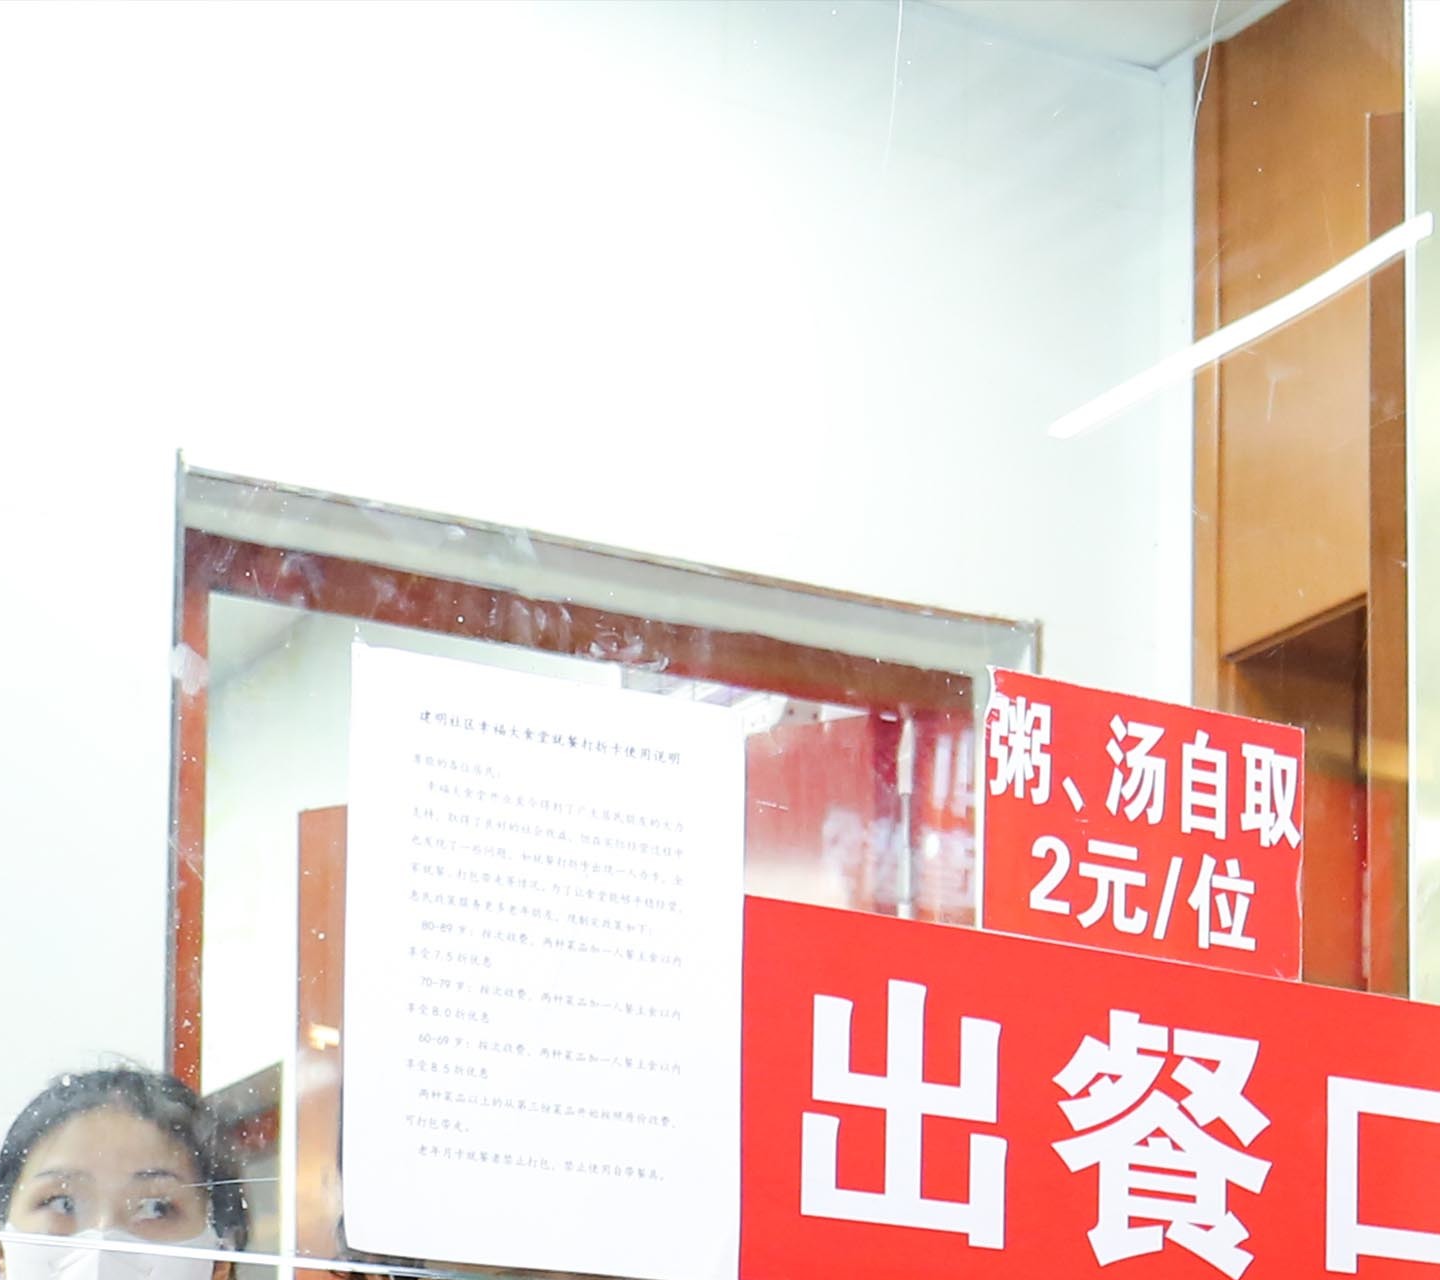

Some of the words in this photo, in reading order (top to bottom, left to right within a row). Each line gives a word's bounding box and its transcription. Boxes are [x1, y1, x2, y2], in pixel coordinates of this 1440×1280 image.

[987, 695, 1302, 849] 粥、汤自取
[1029, 835, 1257, 950] 2元/位
